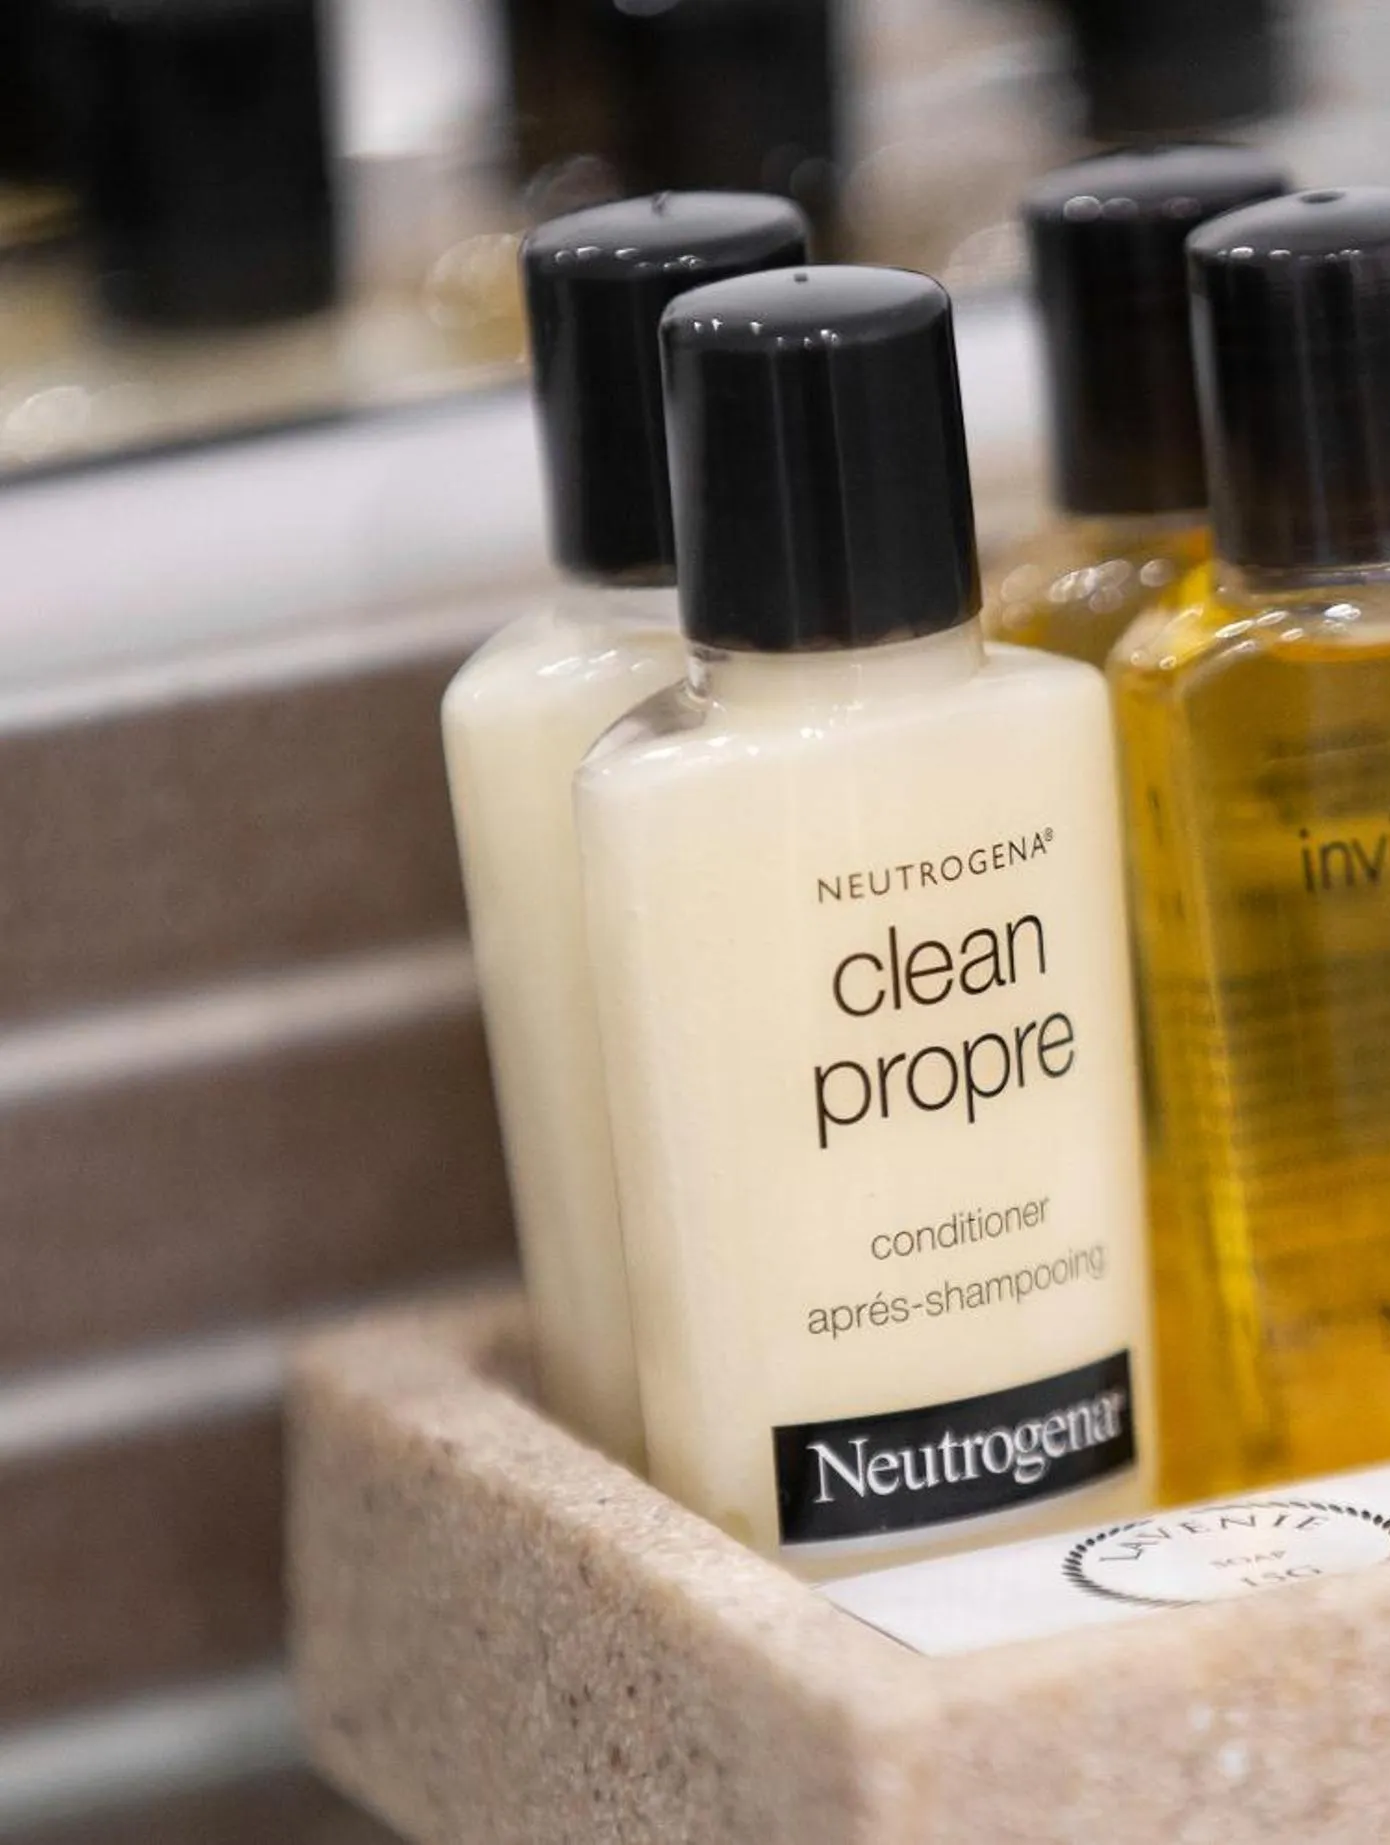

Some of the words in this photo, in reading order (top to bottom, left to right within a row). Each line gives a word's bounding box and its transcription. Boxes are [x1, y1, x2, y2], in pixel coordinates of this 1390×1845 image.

[832, 914, 1045, 1017] clean
[814, 1012, 1075, 1149] propre
[871, 1197, 1050, 1260] conditioner
[807, 1244, 1107, 1340] aprés-shampooing
